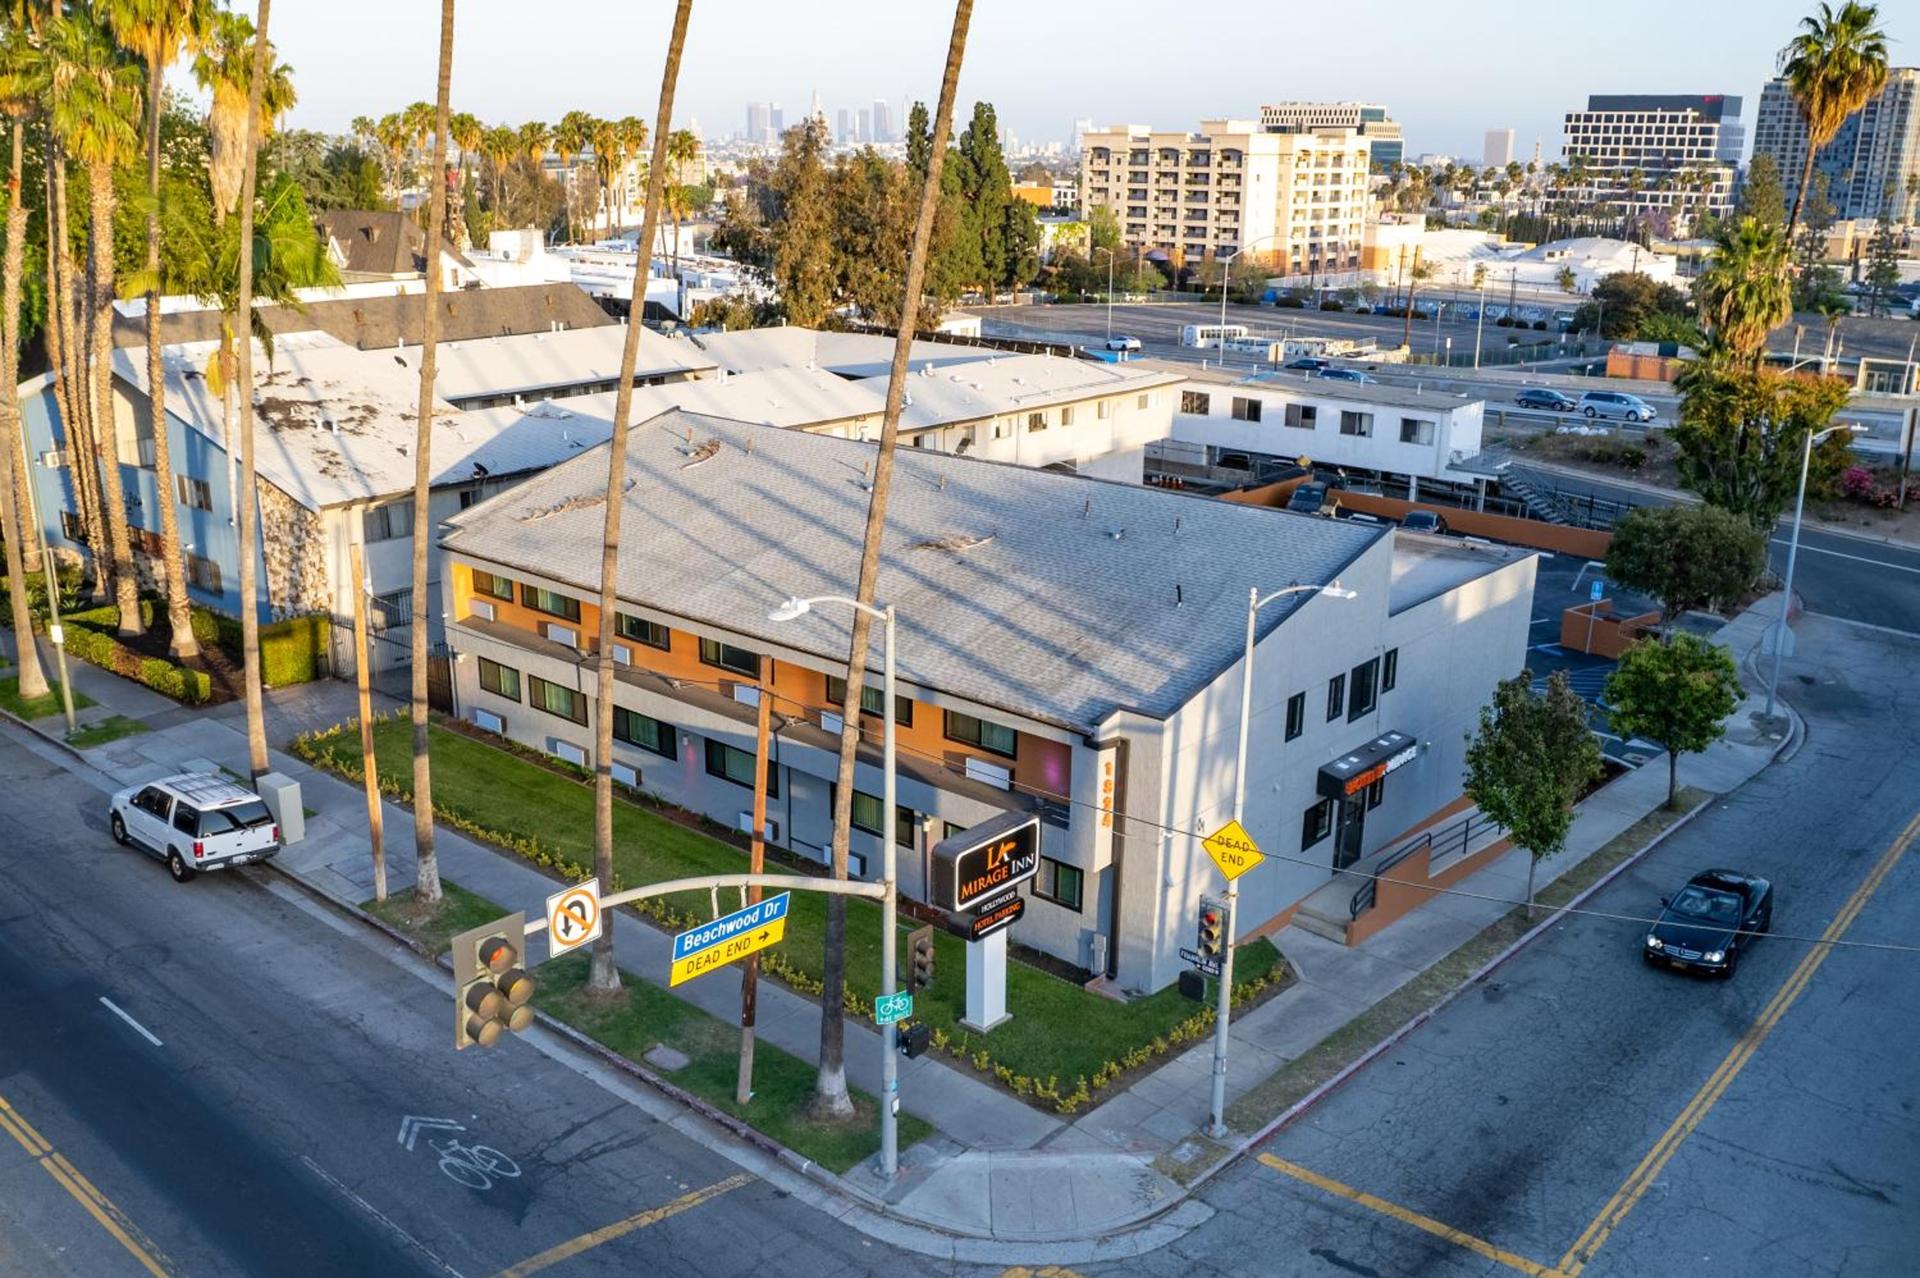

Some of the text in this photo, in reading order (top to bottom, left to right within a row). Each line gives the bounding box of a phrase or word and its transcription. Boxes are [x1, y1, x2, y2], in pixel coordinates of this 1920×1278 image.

[987, 842, 1013, 870] LA
[1218, 835, 1249, 851] DEAD
[1221, 852, 1244, 866] END
[961, 853, 1034, 899] MIRAGE INN
[981, 891, 1016, 913] HOLLYWOOD
[684, 902, 781, 951] Beachwood Dr
[974, 902, 1021, 931] HOTEL PARKING
[687, 938, 751, 974] DEAD END
